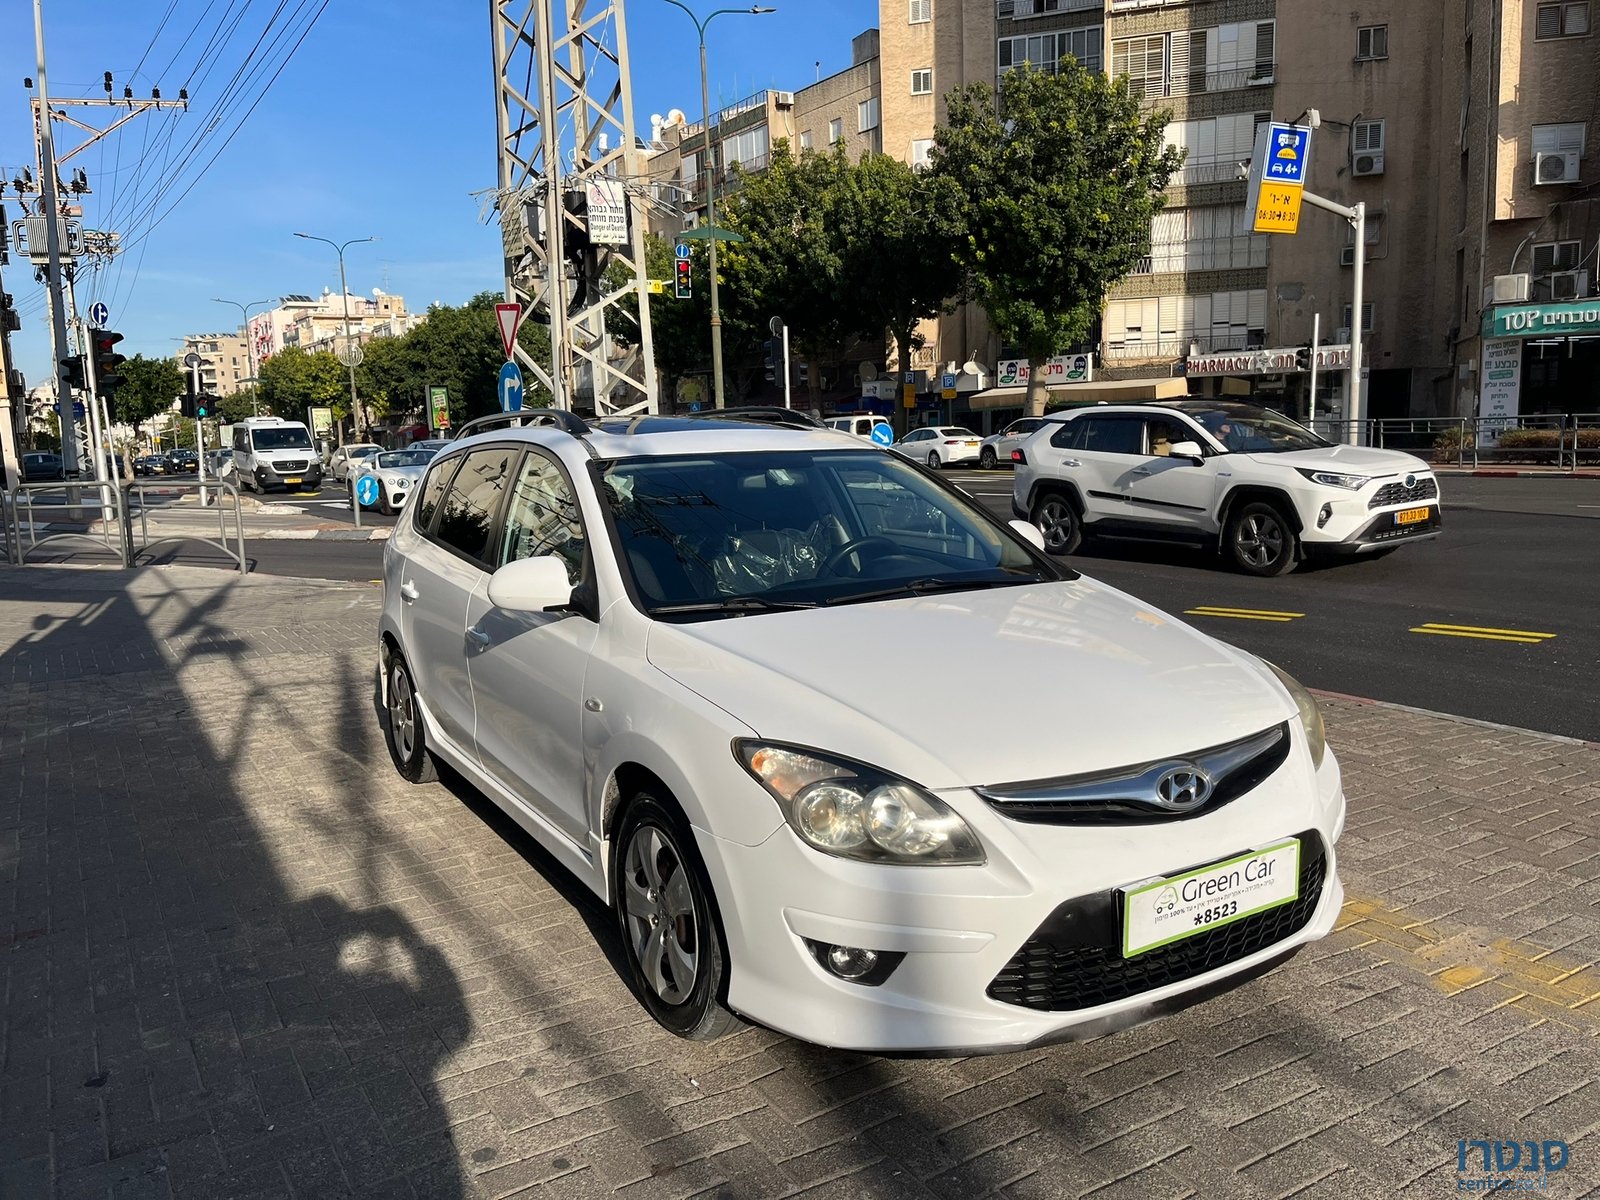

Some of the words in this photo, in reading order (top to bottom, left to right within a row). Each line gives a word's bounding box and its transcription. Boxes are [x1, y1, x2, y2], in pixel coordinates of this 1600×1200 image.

[1285, 163, 1297, 175] 4+
[1502, 310, 1540, 330] TOP
[1542, 309, 1600, 325] טבחים
[1186, 357, 1251, 373] PHARMACY
[1494, 360, 1519, 369] מבצע
[1181, 871, 1240, 903] Green
[1244, 858, 1276, 882] Car
[1169, 908, 1185, 918] 100%
